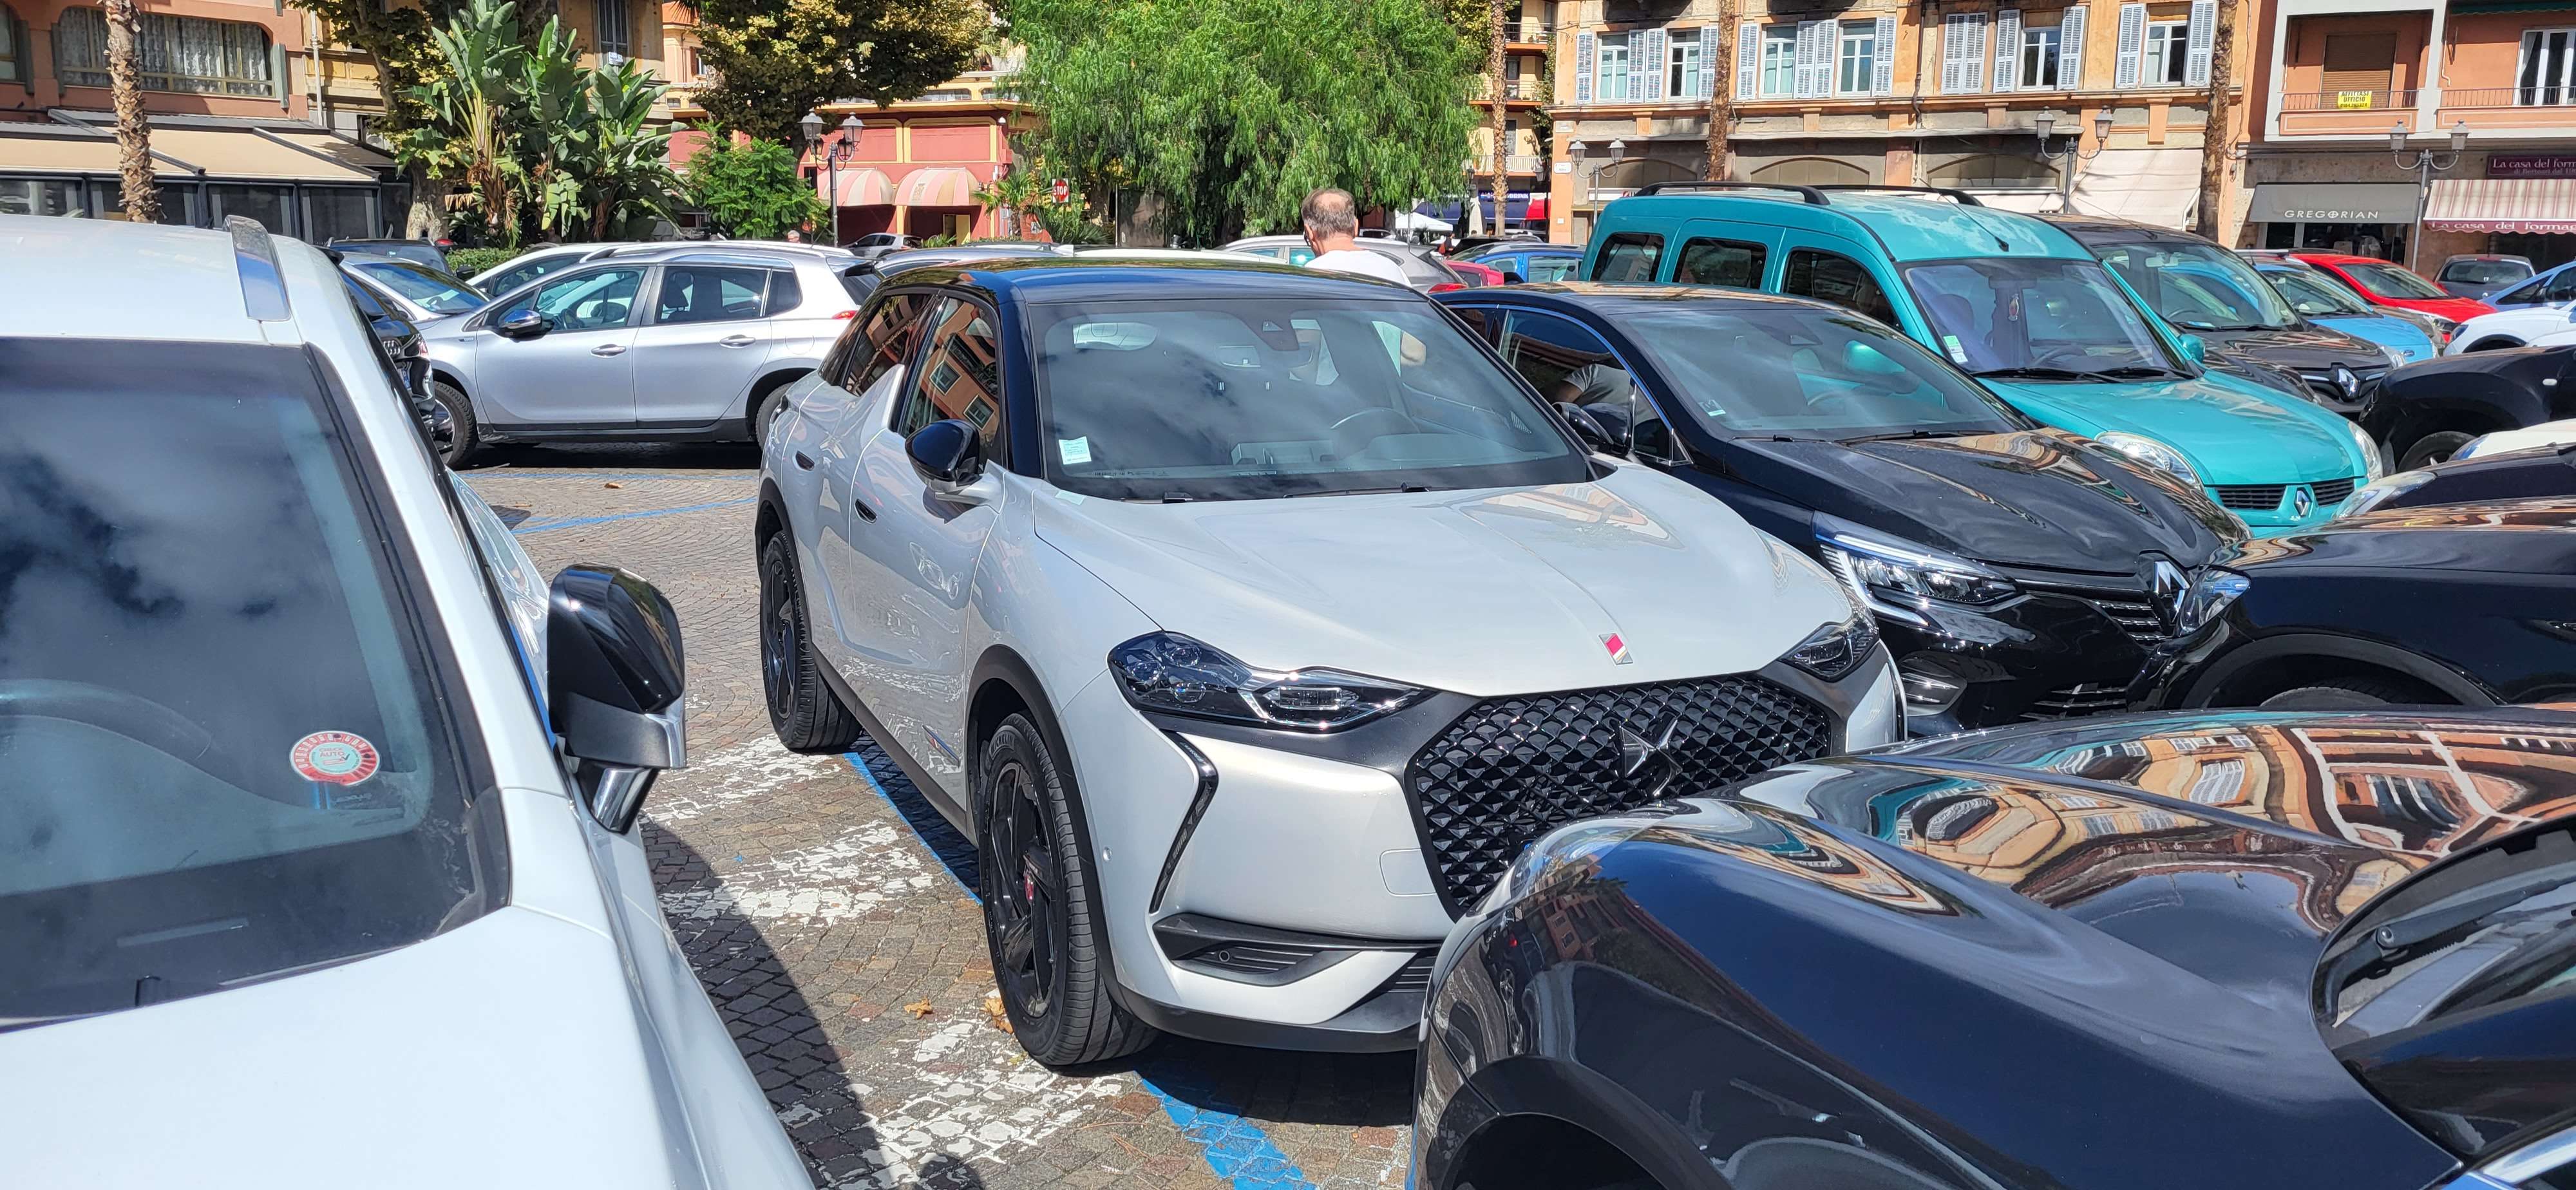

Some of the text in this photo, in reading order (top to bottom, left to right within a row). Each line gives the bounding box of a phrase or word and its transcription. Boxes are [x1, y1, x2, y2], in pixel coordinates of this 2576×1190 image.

[2494, 158, 2506, 168] La
[2534, 158, 2550, 168] del
[1054, 185, 1067, 196] STOP
[2284, 210, 2379, 219] GREGORIAN
